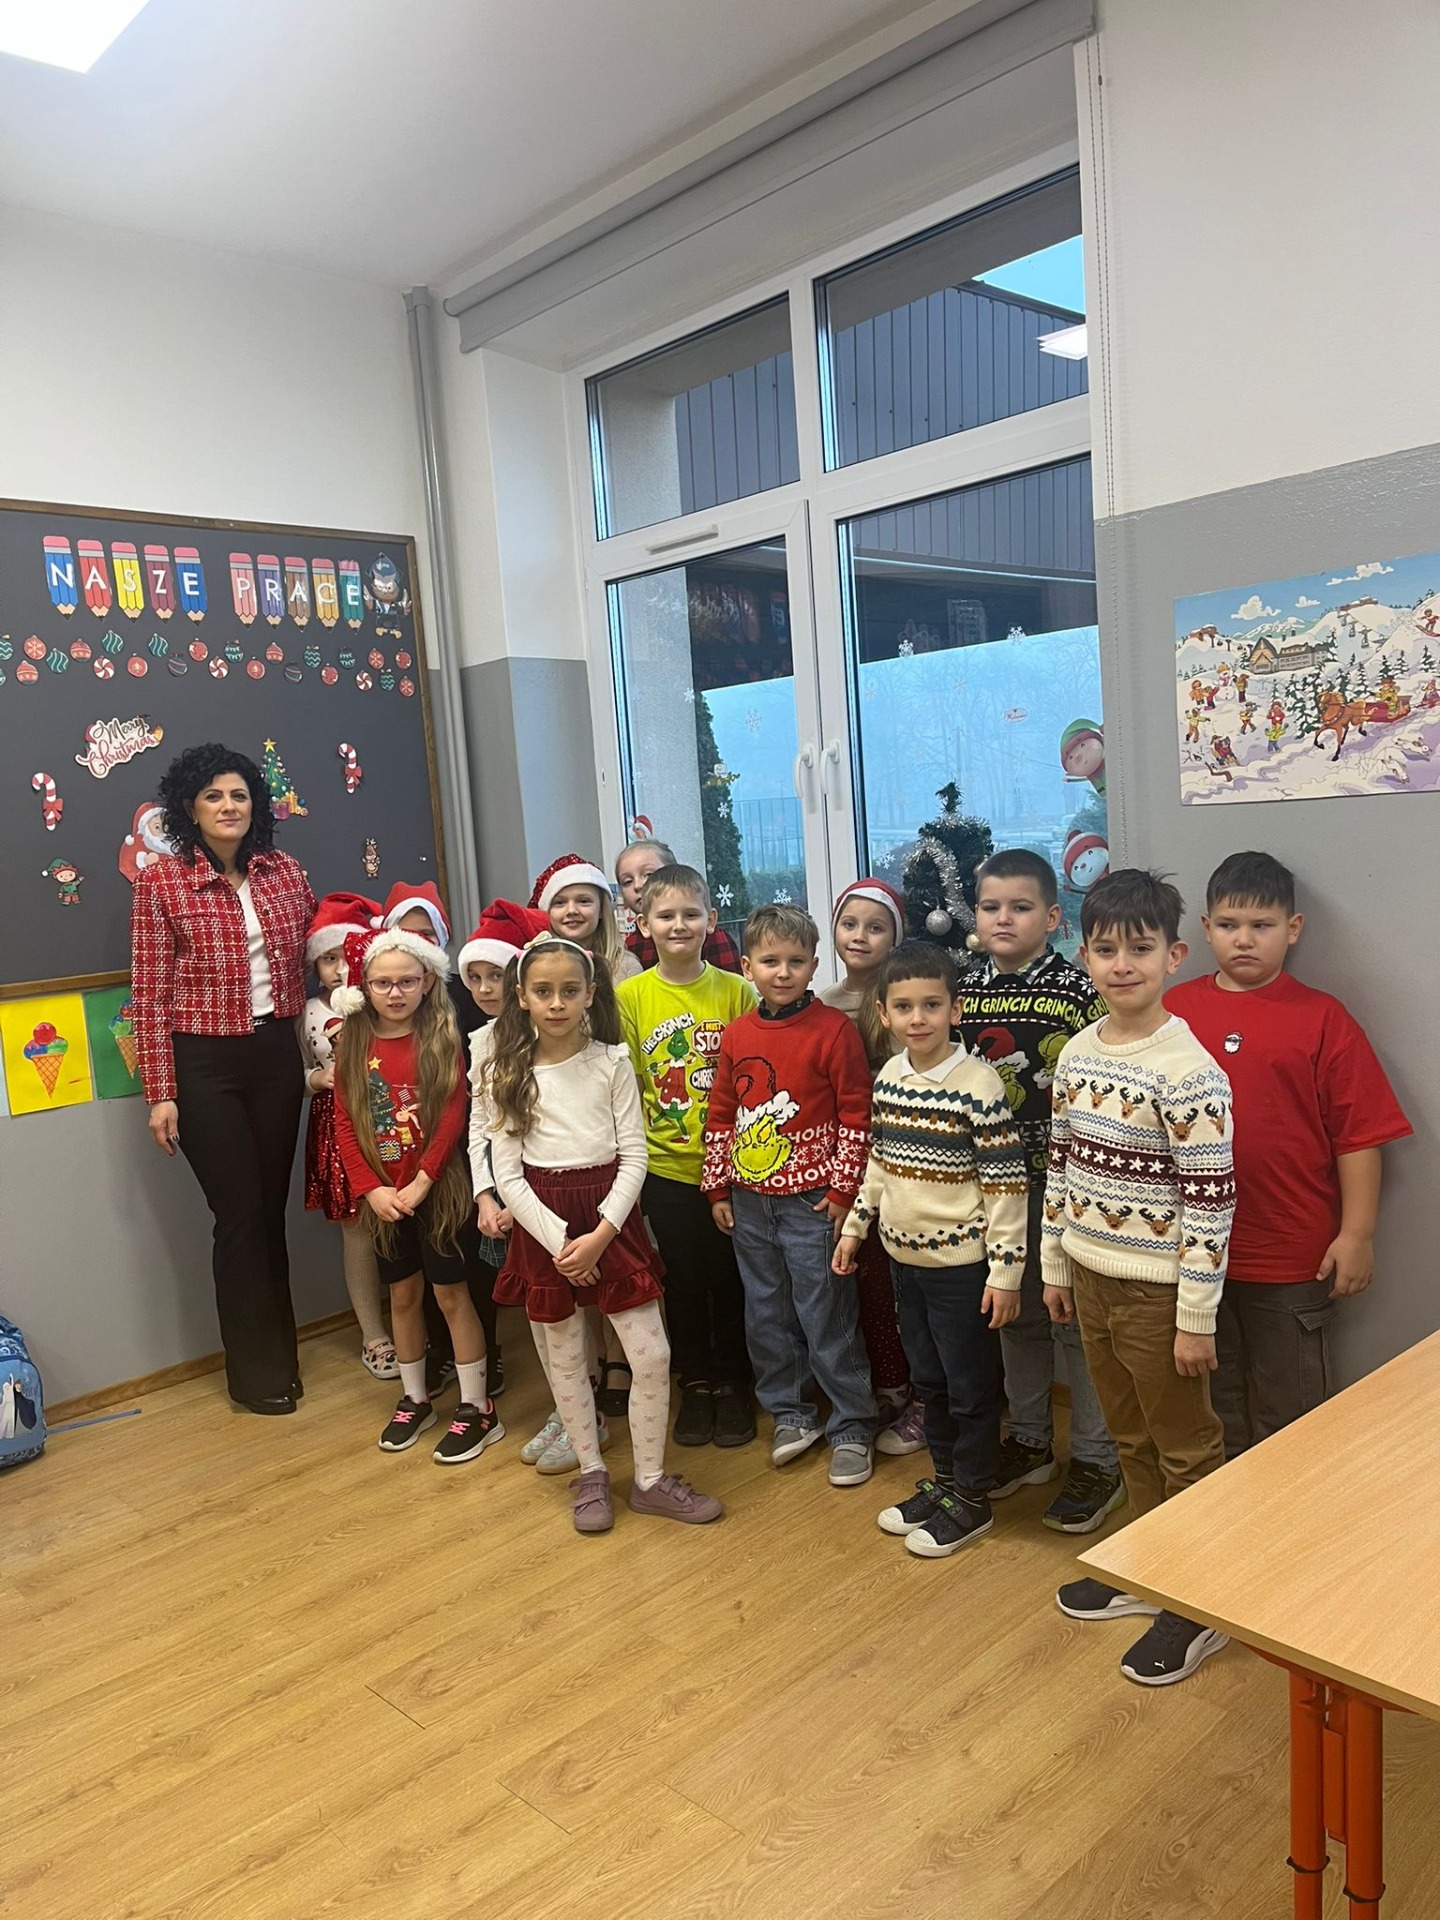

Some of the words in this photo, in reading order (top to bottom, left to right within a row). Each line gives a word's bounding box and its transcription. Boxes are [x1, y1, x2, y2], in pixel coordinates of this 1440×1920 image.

[50, 563, 200, 596] NASZE
[236, 577, 361, 606] PRACE
[93, 719, 147, 744] Merry
[77, 737, 159, 775] Christmas
[980, 996, 1032, 1014] GRINCH
[1033, 996, 1081, 1028] GRINCH
[642, 1036, 660, 1054] THE
[696, 1032, 723, 1051] STO
